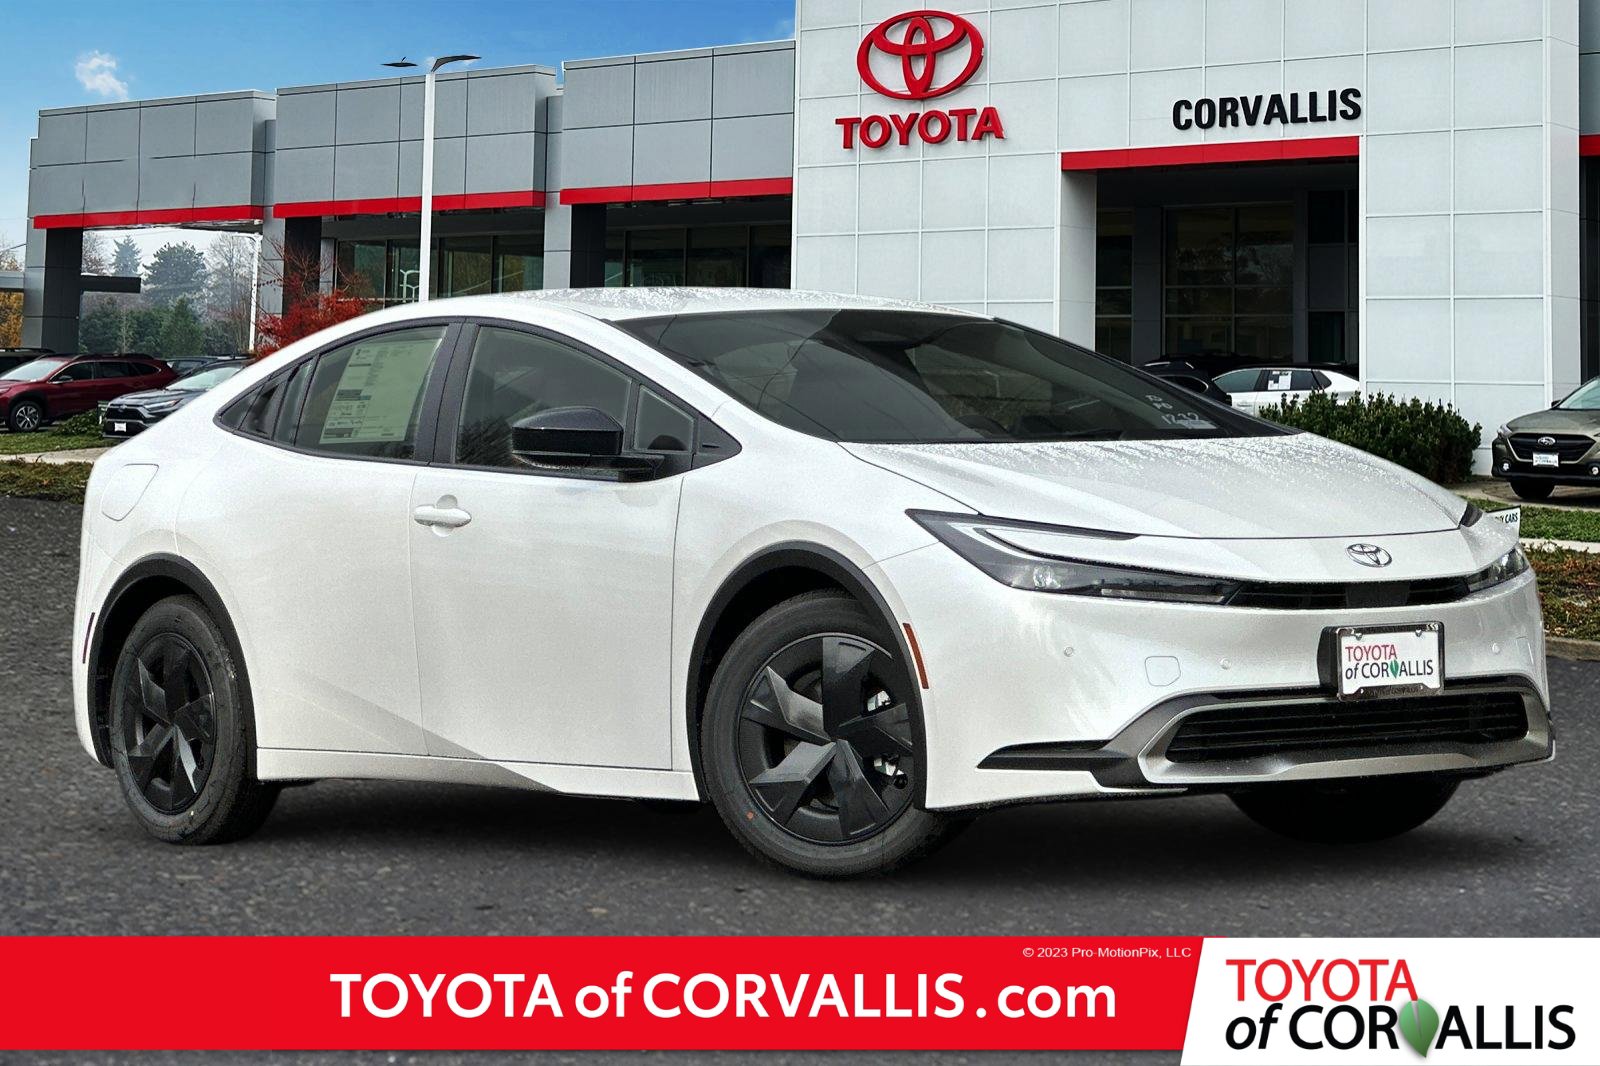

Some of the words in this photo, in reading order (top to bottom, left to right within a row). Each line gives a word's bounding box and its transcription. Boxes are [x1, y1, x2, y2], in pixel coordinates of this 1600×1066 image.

[1172, 87, 1362, 131] CORVALLIS
[835, 106, 1005, 149] TOYOTA
[1345, 644, 1398, 662] TOYOTA
[1345, 662, 1360, 680] of
